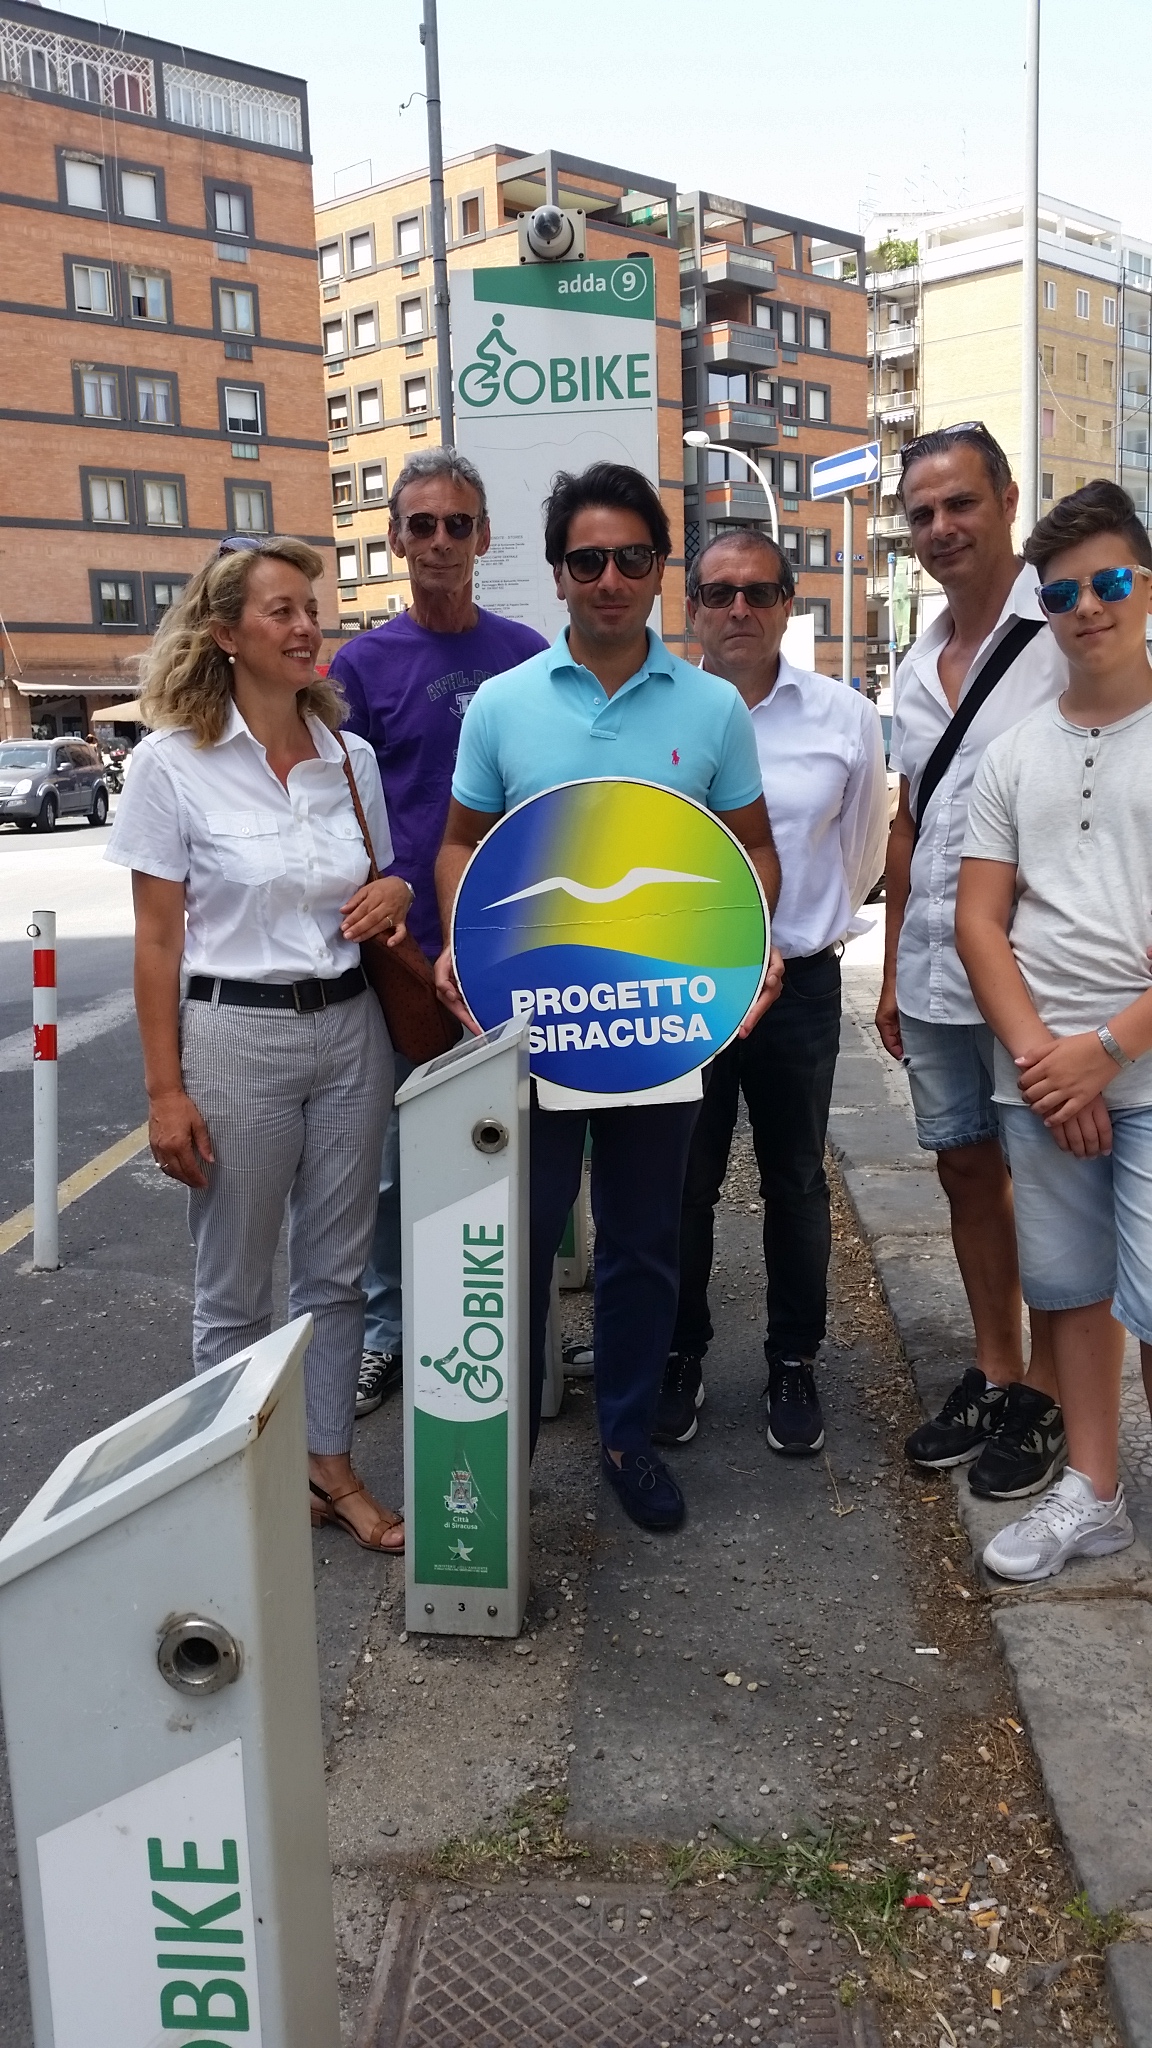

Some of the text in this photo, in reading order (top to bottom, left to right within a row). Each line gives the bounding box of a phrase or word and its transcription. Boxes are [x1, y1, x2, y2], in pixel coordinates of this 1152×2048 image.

[557, 271, 636, 294] adda 9
[458, 353, 652, 407] GOBIKE
[511, 975, 716, 1017] PROGETTO
[529, 1013, 712, 1054] SIRACUSA
[463, 1223, 504, 1403] GOBIKE
[458, 1603, 466, 1612] 3
[147, 1837, 250, 2048] BIKE
